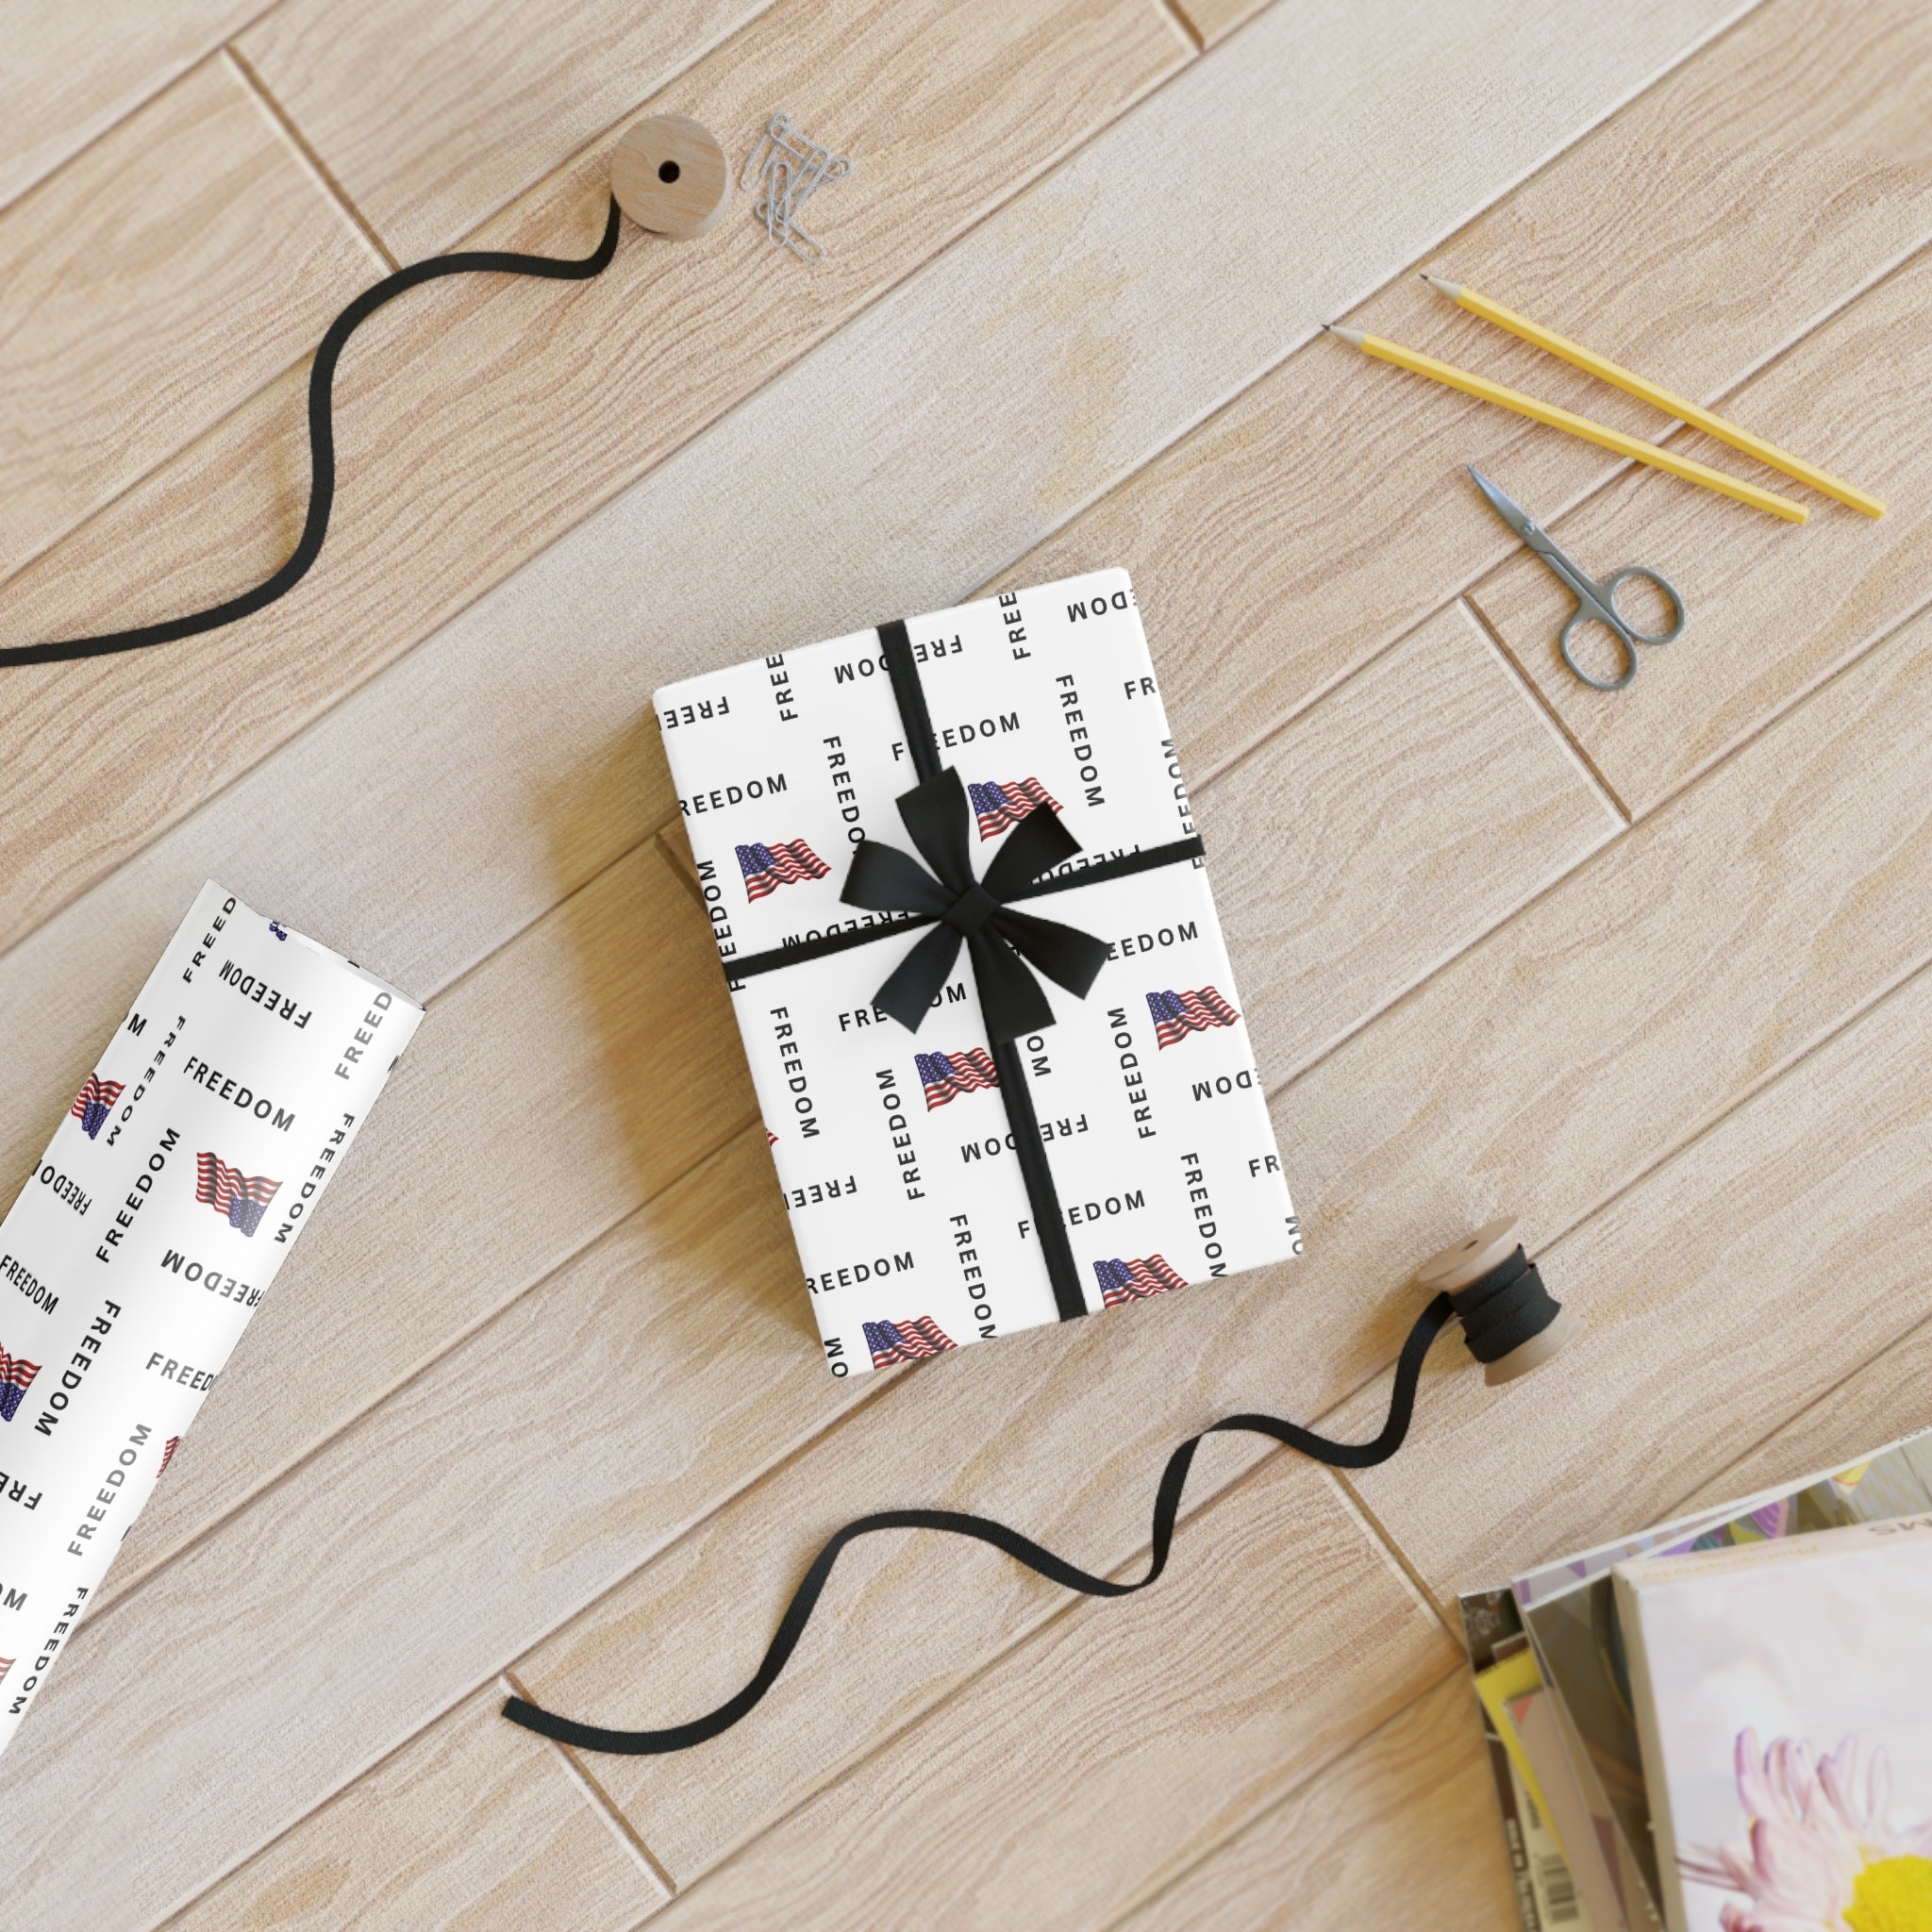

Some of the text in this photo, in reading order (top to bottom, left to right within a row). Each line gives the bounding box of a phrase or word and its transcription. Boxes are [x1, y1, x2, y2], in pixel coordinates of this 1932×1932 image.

[1056, 675, 1105, 807] FREEDOM
[219, 958, 313, 1030] FREEDOM
[107, 1015, 186, 1148] FREEDOM
[184, 1056, 295, 1132] FREEDOM
[769, 1006, 821, 1140] FREEDOM
[875, 1068, 925, 1201] FREEDOM
[1107, 1007, 1157, 1141] FREEDOM
[95, 1127, 180, 1264] FREEDOM
[274, 1112, 355, 1243] FREEDOM
[0, 1255, 59, 1315] FREEDOM
[34, 1299, 122, 1437] FREEDOM
[68, 1423, 153, 1557] FREEDOM
[8, 1586, 90, 1715] FREEDOM
